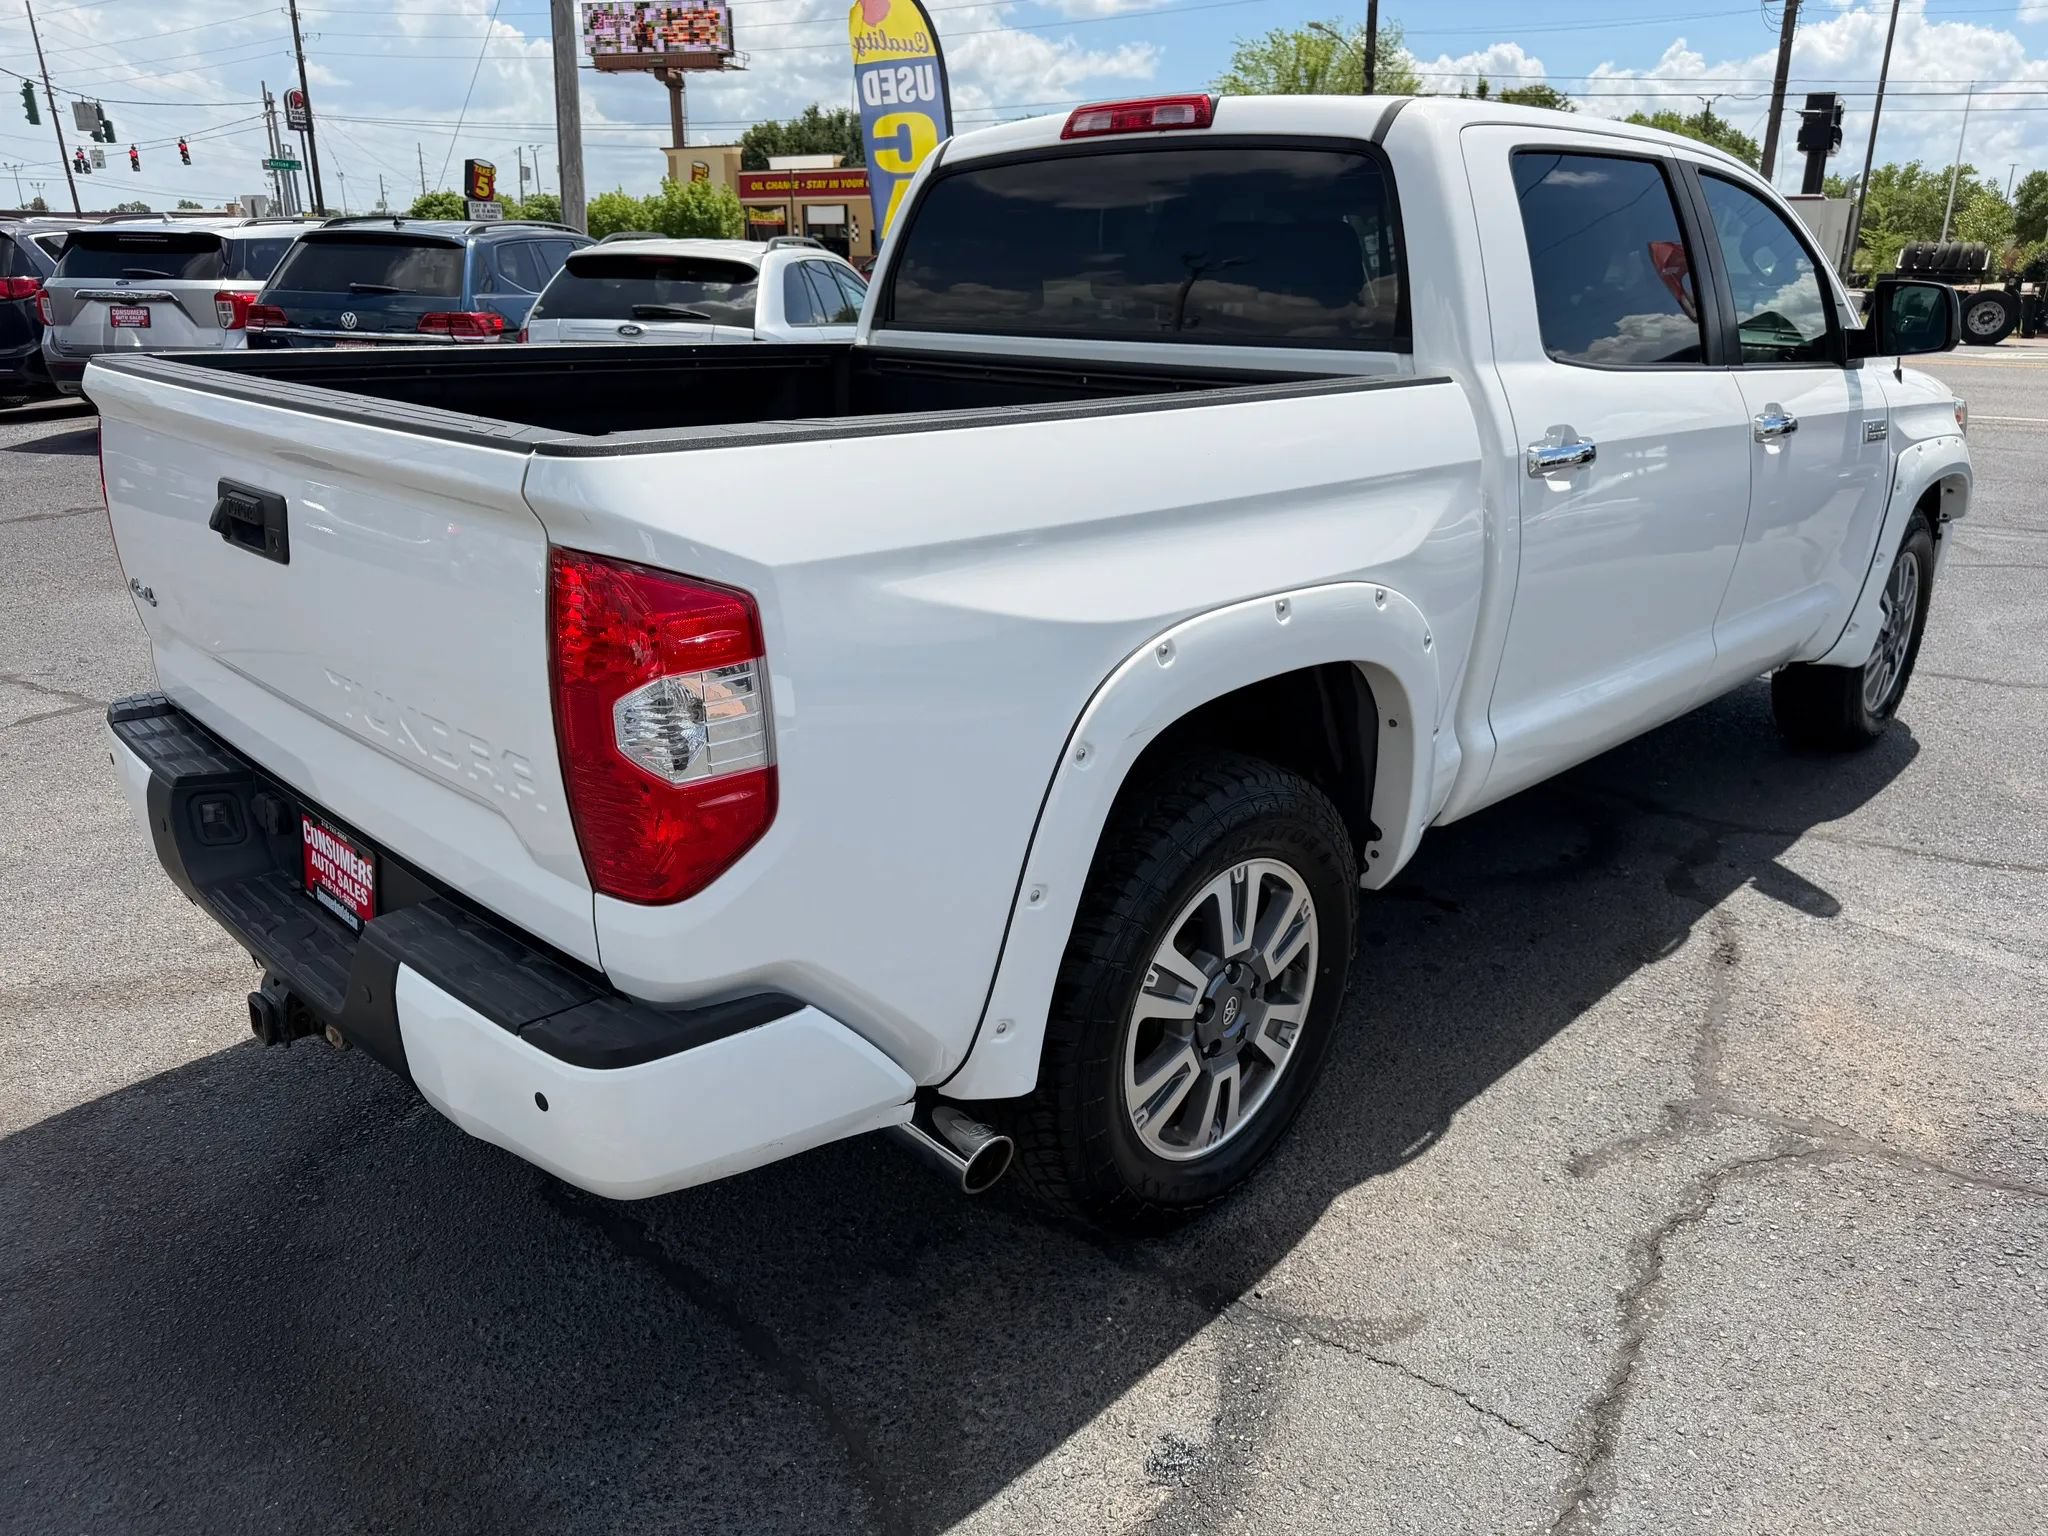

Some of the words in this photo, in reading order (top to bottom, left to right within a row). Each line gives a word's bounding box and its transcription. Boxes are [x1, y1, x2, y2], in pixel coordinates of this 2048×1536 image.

[474, 165, 492, 176] TAKE
[475, 175, 490, 198] 5
[751, 182, 765, 191] OIL
[806, 180, 828, 189] STAY
[829, 180, 840, 189] IN
[841, 179, 865, 189] YOUR
[302, 819, 374, 891] CONSUMERS
[311, 849, 336, 880] AUTO
[336, 869, 368, 907] SALES
